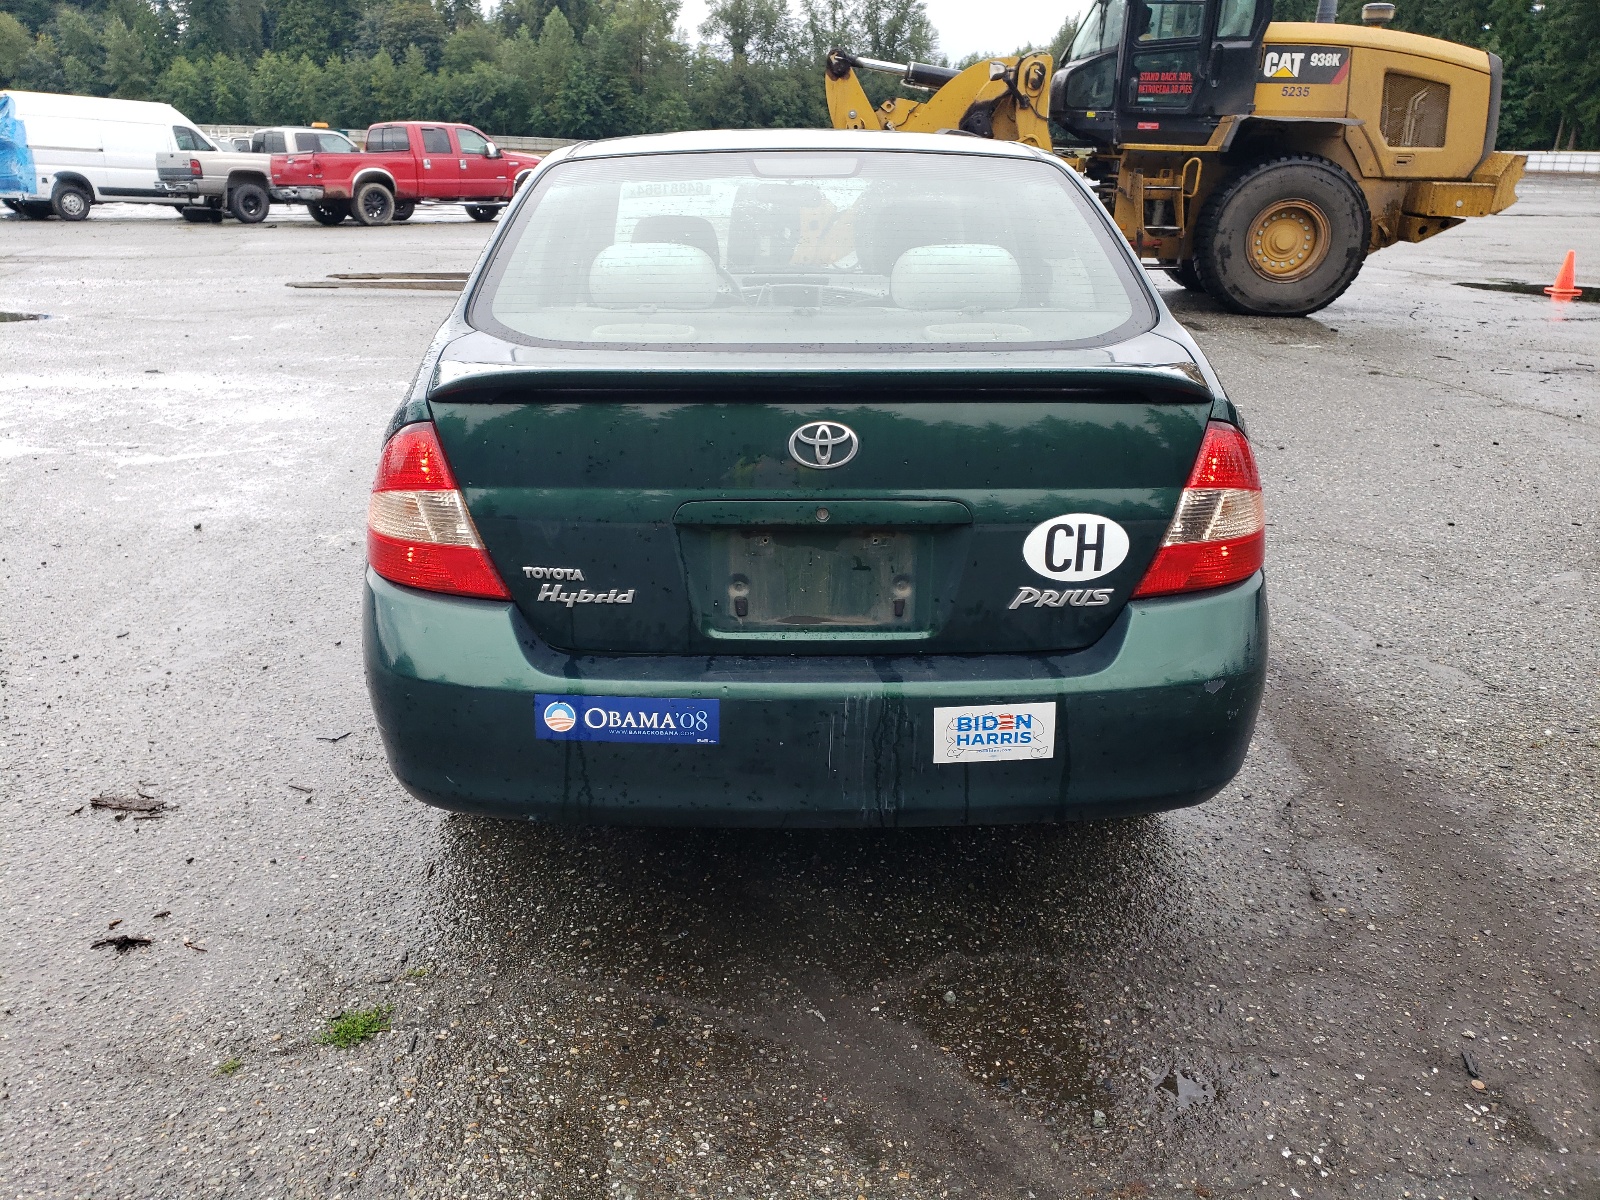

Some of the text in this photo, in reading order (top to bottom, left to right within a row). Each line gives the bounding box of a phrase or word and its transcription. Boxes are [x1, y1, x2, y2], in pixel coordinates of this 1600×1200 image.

[1263, 52, 1341, 77] CAT 938K
[1140, 72, 1160, 81] STAND
[1281, 86, 1310, 97] 5235
[1045, 523, 1105, 572] CH
[522, 566, 585, 581] TOYOTA
[537, 583, 635, 607] Hybrid
[1008, 586, 1115, 610] PRIUS
[957, 713, 1032, 732] BIDEN
[956, 731, 1032, 746] HARRIS
